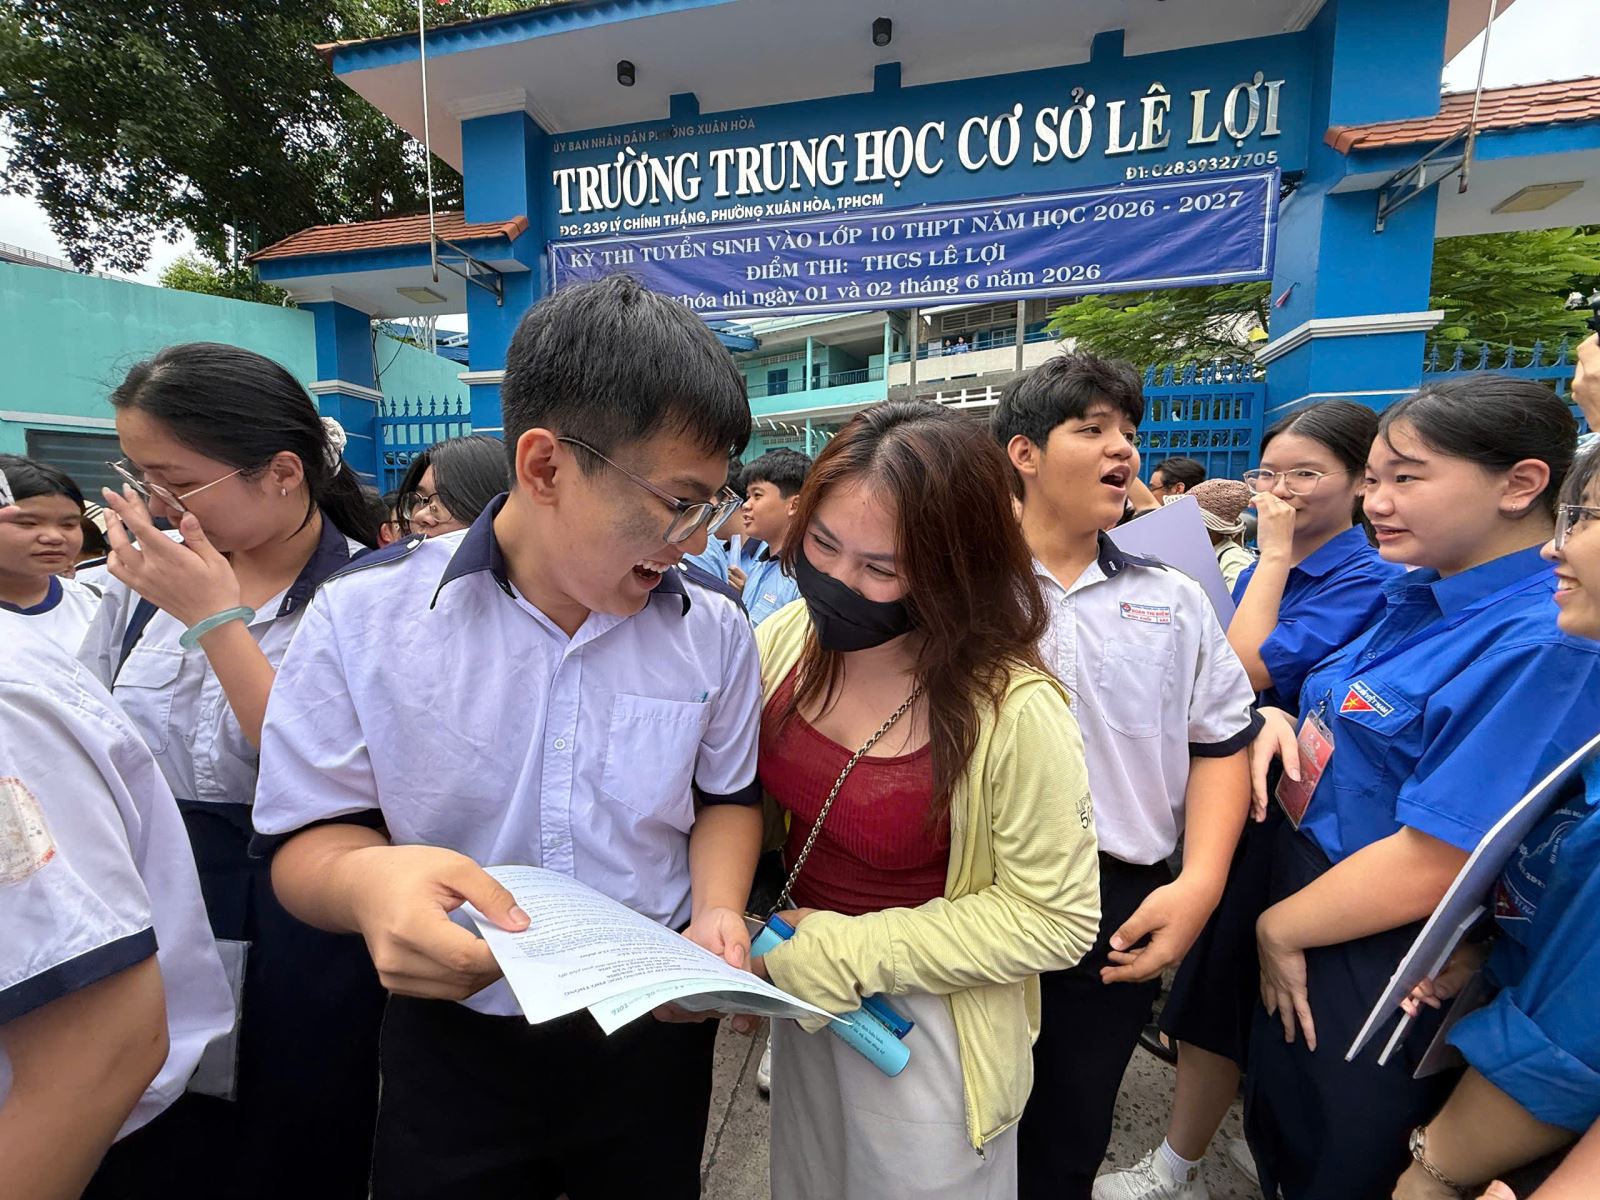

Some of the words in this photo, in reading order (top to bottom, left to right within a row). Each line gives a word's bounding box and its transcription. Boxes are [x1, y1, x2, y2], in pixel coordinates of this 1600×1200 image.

[553, 146, 702, 214] TRƯỜNG
[710, 134, 848, 197] TRUNG
[854, 121, 946, 188] HỌC
[958, 102, 1024, 170] CƠ
[1033, 86, 1096, 163] SỞ
[1104, 81, 1171, 155] LÊ
[1187, 71, 1285, 148] LỢI
[568, 139, 589, 151] BAN
[591, 135, 621, 149] NHÂN
[624, 130, 646, 145] DÂN
[698, 119, 729, 135] XUÂN
[731, 115, 756, 130] HÒA
[1151, 150, 1279, 177] 02839327705
[571, 248, 595, 268] KỲ
[601, 249, 634, 266] THI
[640, 235, 706, 262] TUYỂN
[712, 237, 761, 256] SINH
[766, 230, 812, 251] VÀO
[818, 224, 863, 247] LỚP
[871, 225, 896, 242] 10
[901, 218, 965, 240] THPT
[970, 208, 1025, 234] NĂM
[1031, 206, 1087, 231] HỌC
[1093, 199, 1155, 223] 2026
[1178, 191, 1244, 213] 2027
[583, 221, 608, 235] 239
[610, 215, 622, 232] LÝ
[623, 213, 660, 231] CHÍNH
[711, 204, 763, 220] PHƯỜNG
[765, 199, 800, 216] XUÂN
[803, 195, 836, 212] HÒA,
[836, 193, 884, 209] TPHCM
[746, 256, 799, 281] ĐIỂM
[805, 259, 848, 276] THI:
[861, 252, 922, 272] THCS
[929, 244, 959, 267] LÊ
[965, 242, 1006, 264] LỢI
[722, 290, 747, 307] thi
[753, 286, 799, 307] ngày
[805, 286, 827, 301] 01
[837, 281, 861, 298] và
[866, 281, 893, 297] 02
[899, 275, 959, 294] tháng
[965, 274, 979, 290] 6
[985, 269, 1035, 288] năm
[1041, 264, 1101, 283] 2026
